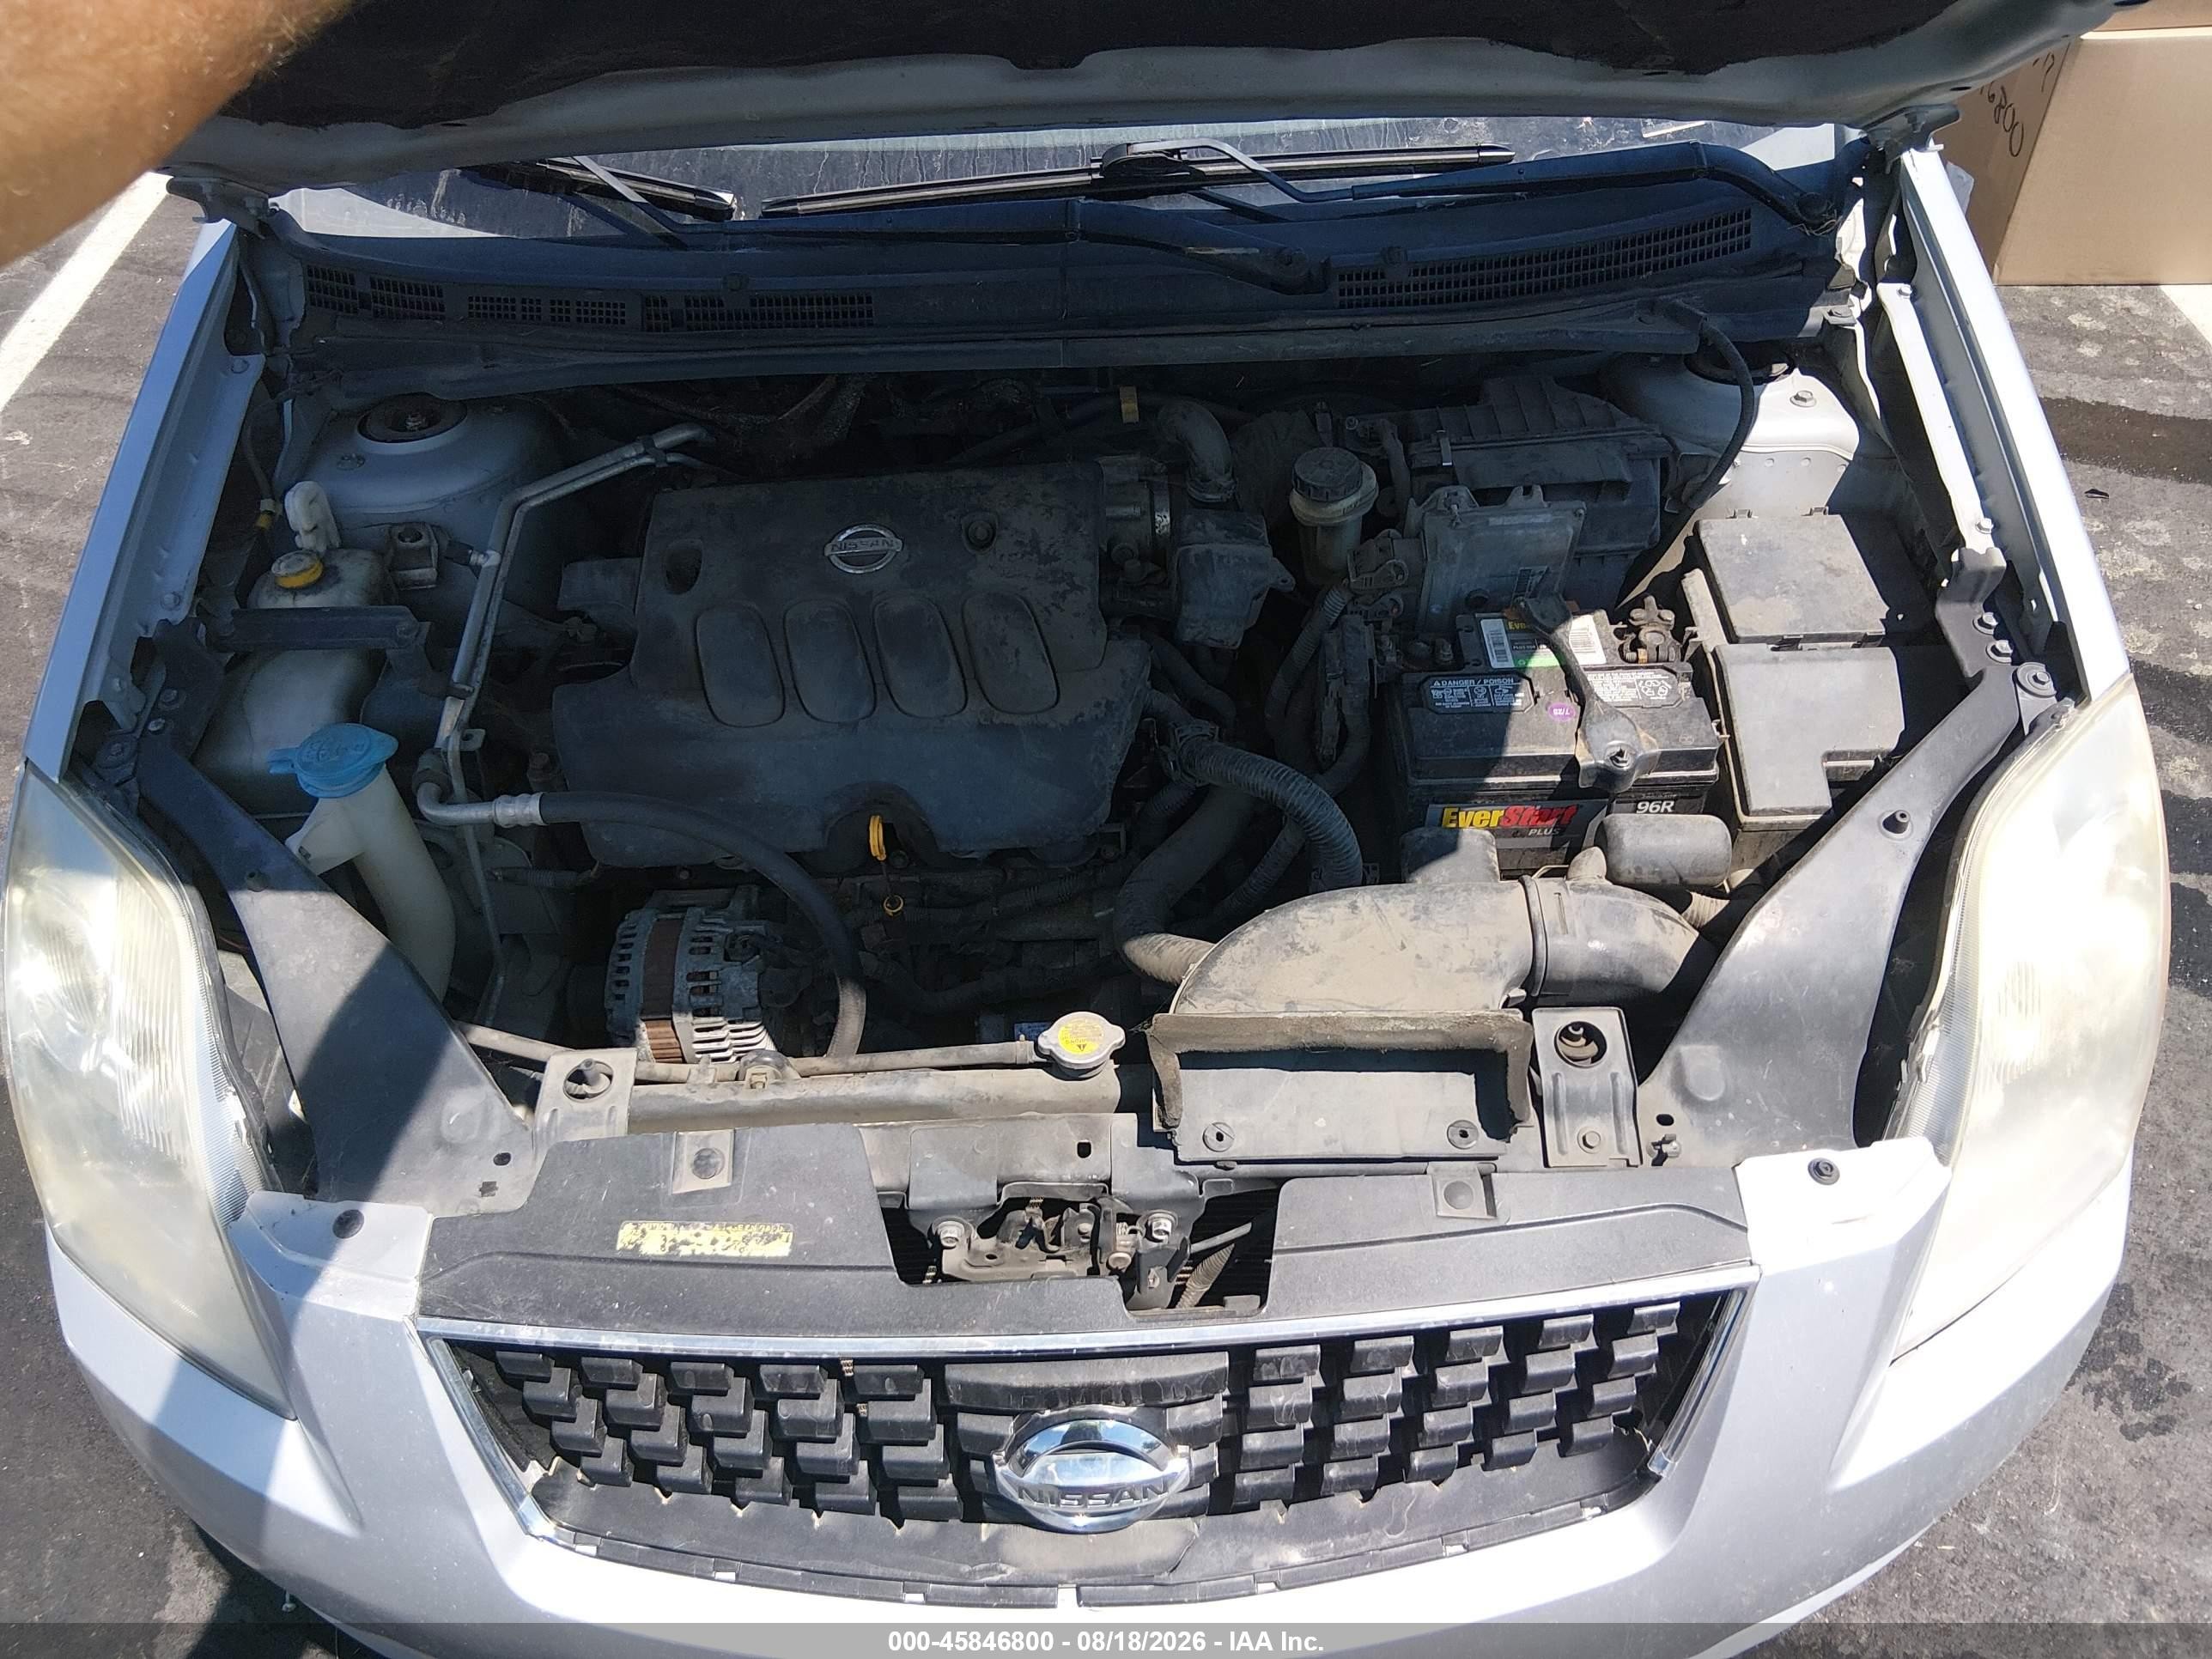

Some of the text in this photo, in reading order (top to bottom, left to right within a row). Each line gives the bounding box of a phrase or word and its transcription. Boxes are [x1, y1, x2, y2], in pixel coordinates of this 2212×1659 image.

[831, 539, 894, 552] NISSAN
[1483, 677, 1514, 685] POISON
[1636, 800, 1675, 814] 96R
[1442, 804, 1578, 829] EverStart
[1528, 827, 1561, 836] PLUS
[1018, 1481, 1170, 1509] NISSAN
